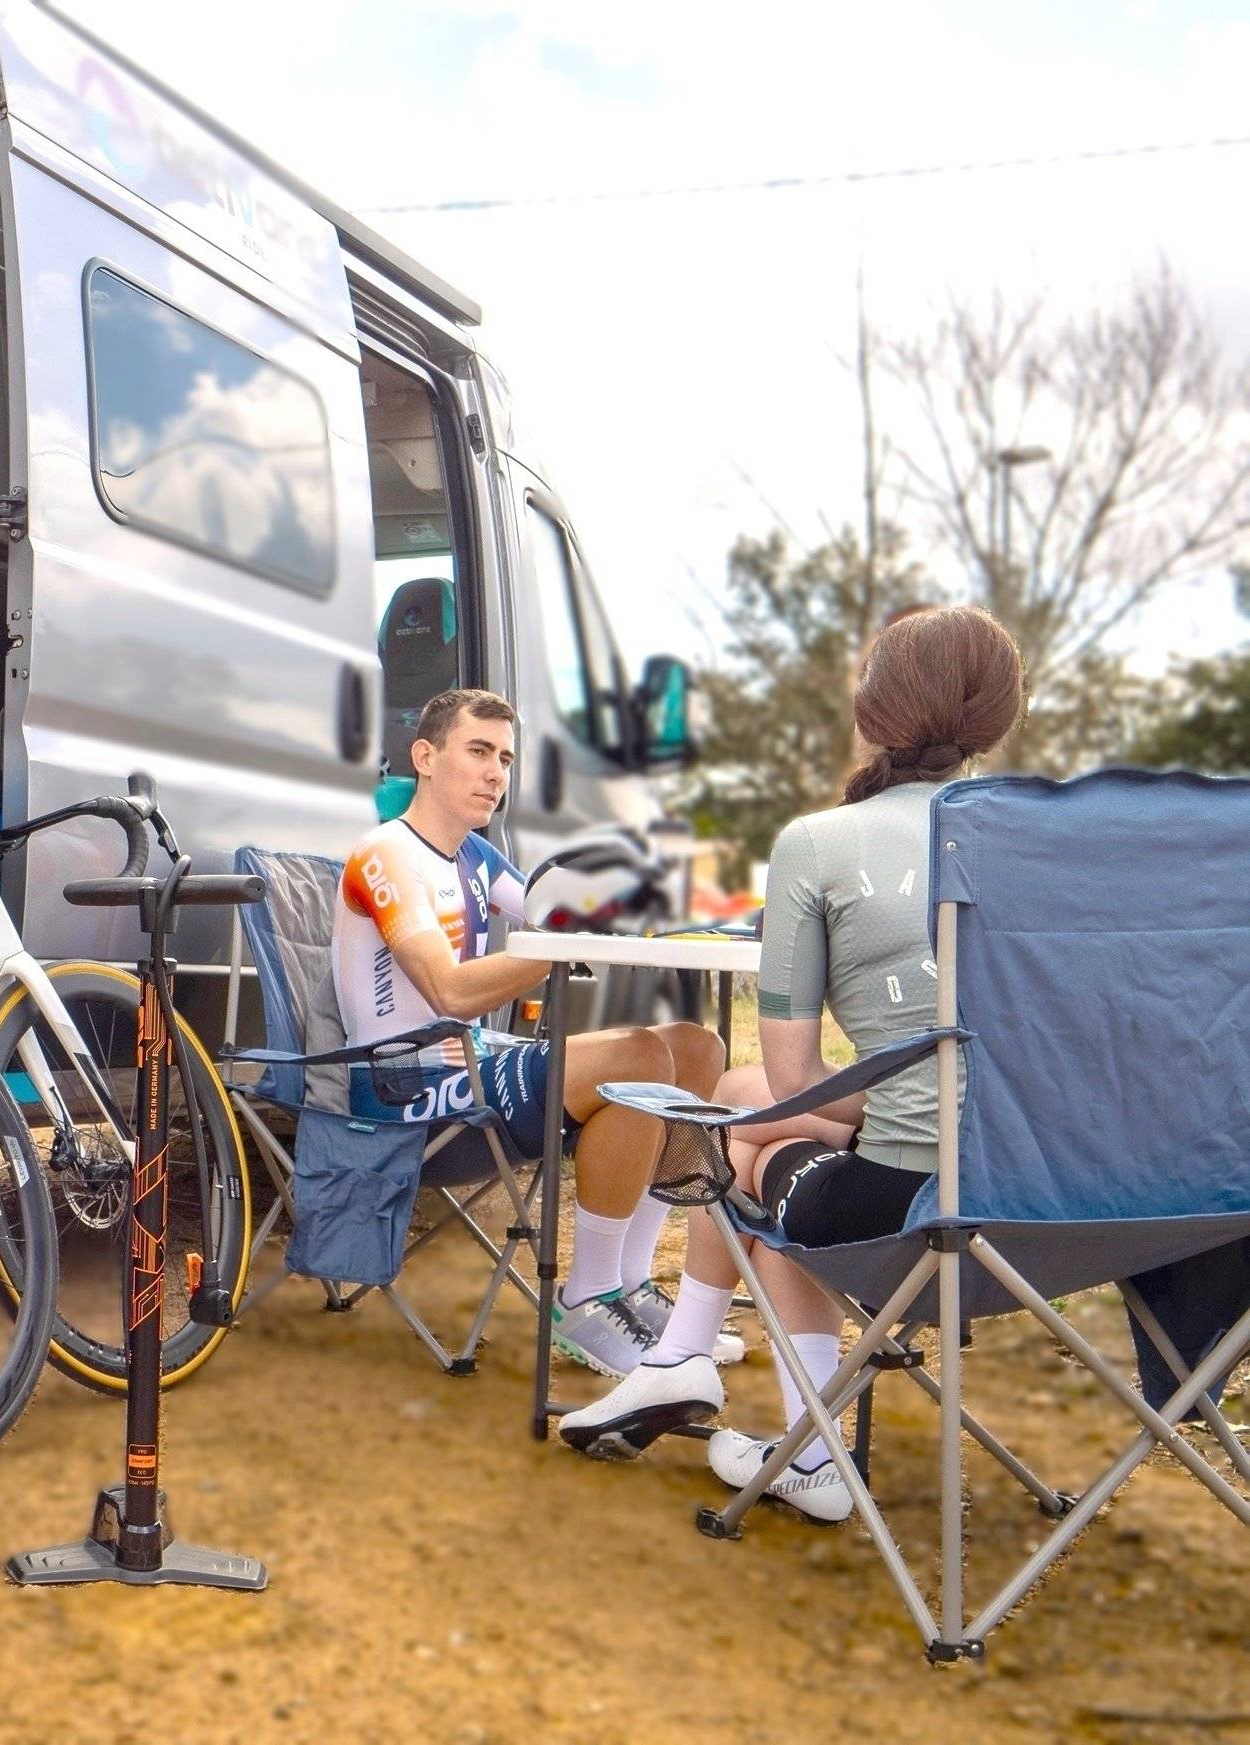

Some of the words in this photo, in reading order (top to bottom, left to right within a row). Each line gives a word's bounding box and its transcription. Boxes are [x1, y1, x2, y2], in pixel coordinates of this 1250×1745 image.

[150, 1059, 159, 1096] GERMANY
[150, 1098, 158, 1107] IN
[768, 1470, 841, 1498] PECIALIZE
